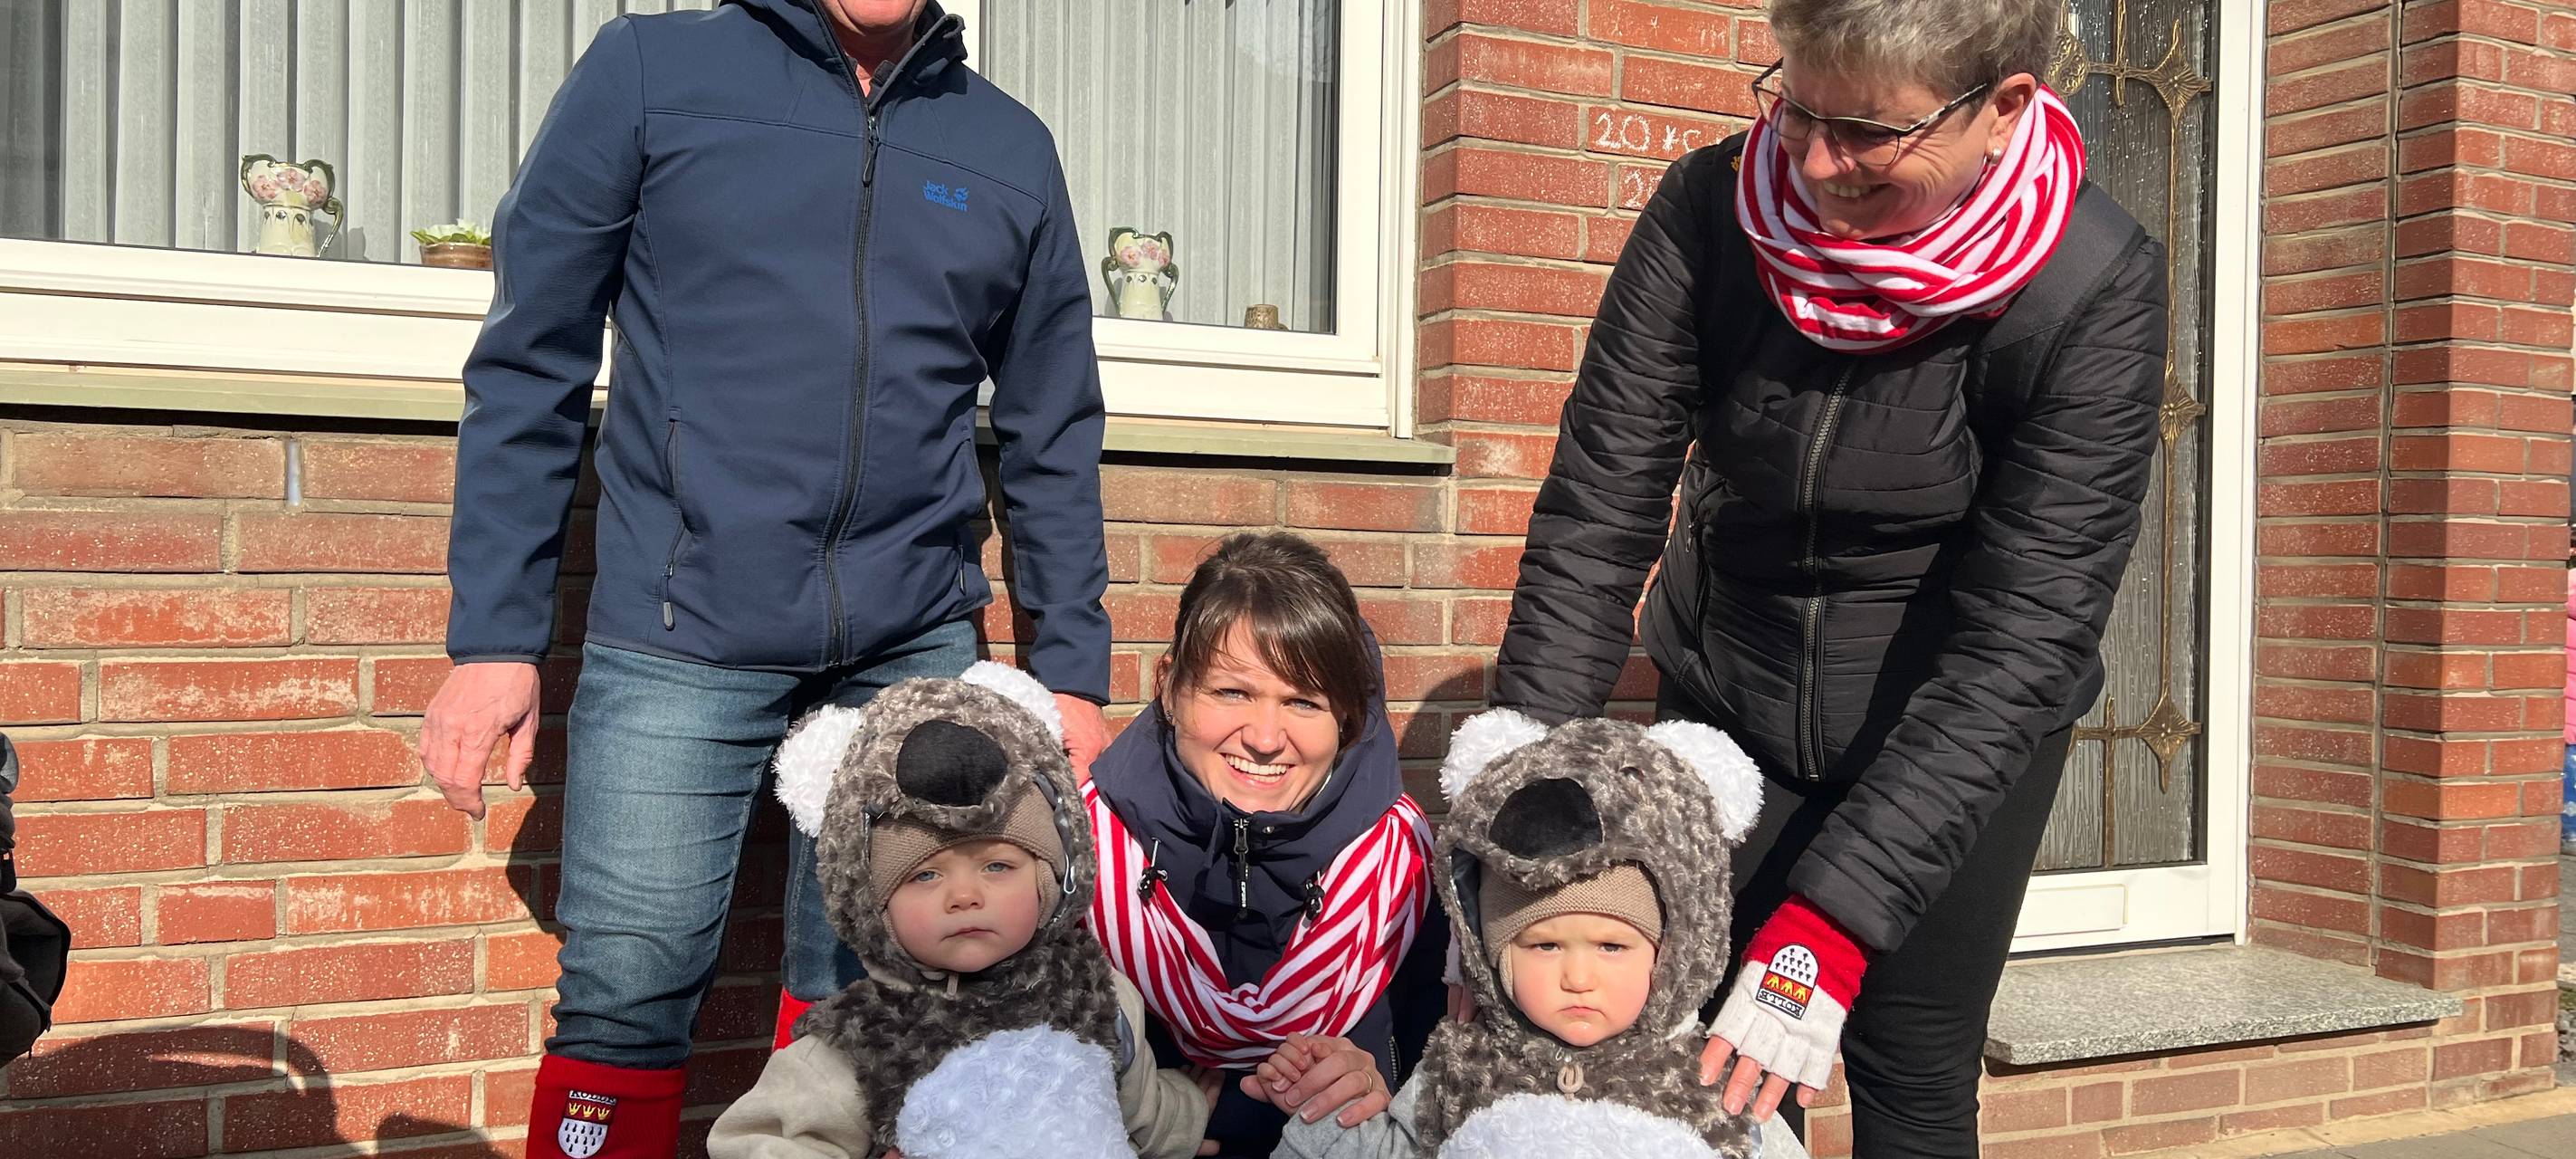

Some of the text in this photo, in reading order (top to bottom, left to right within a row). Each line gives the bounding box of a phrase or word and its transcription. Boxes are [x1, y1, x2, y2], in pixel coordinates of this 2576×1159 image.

[1596, 111, 1651, 152] 20
[923, 187, 968, 212] Wolfskin
[926, 180, 949, 196] Jack
